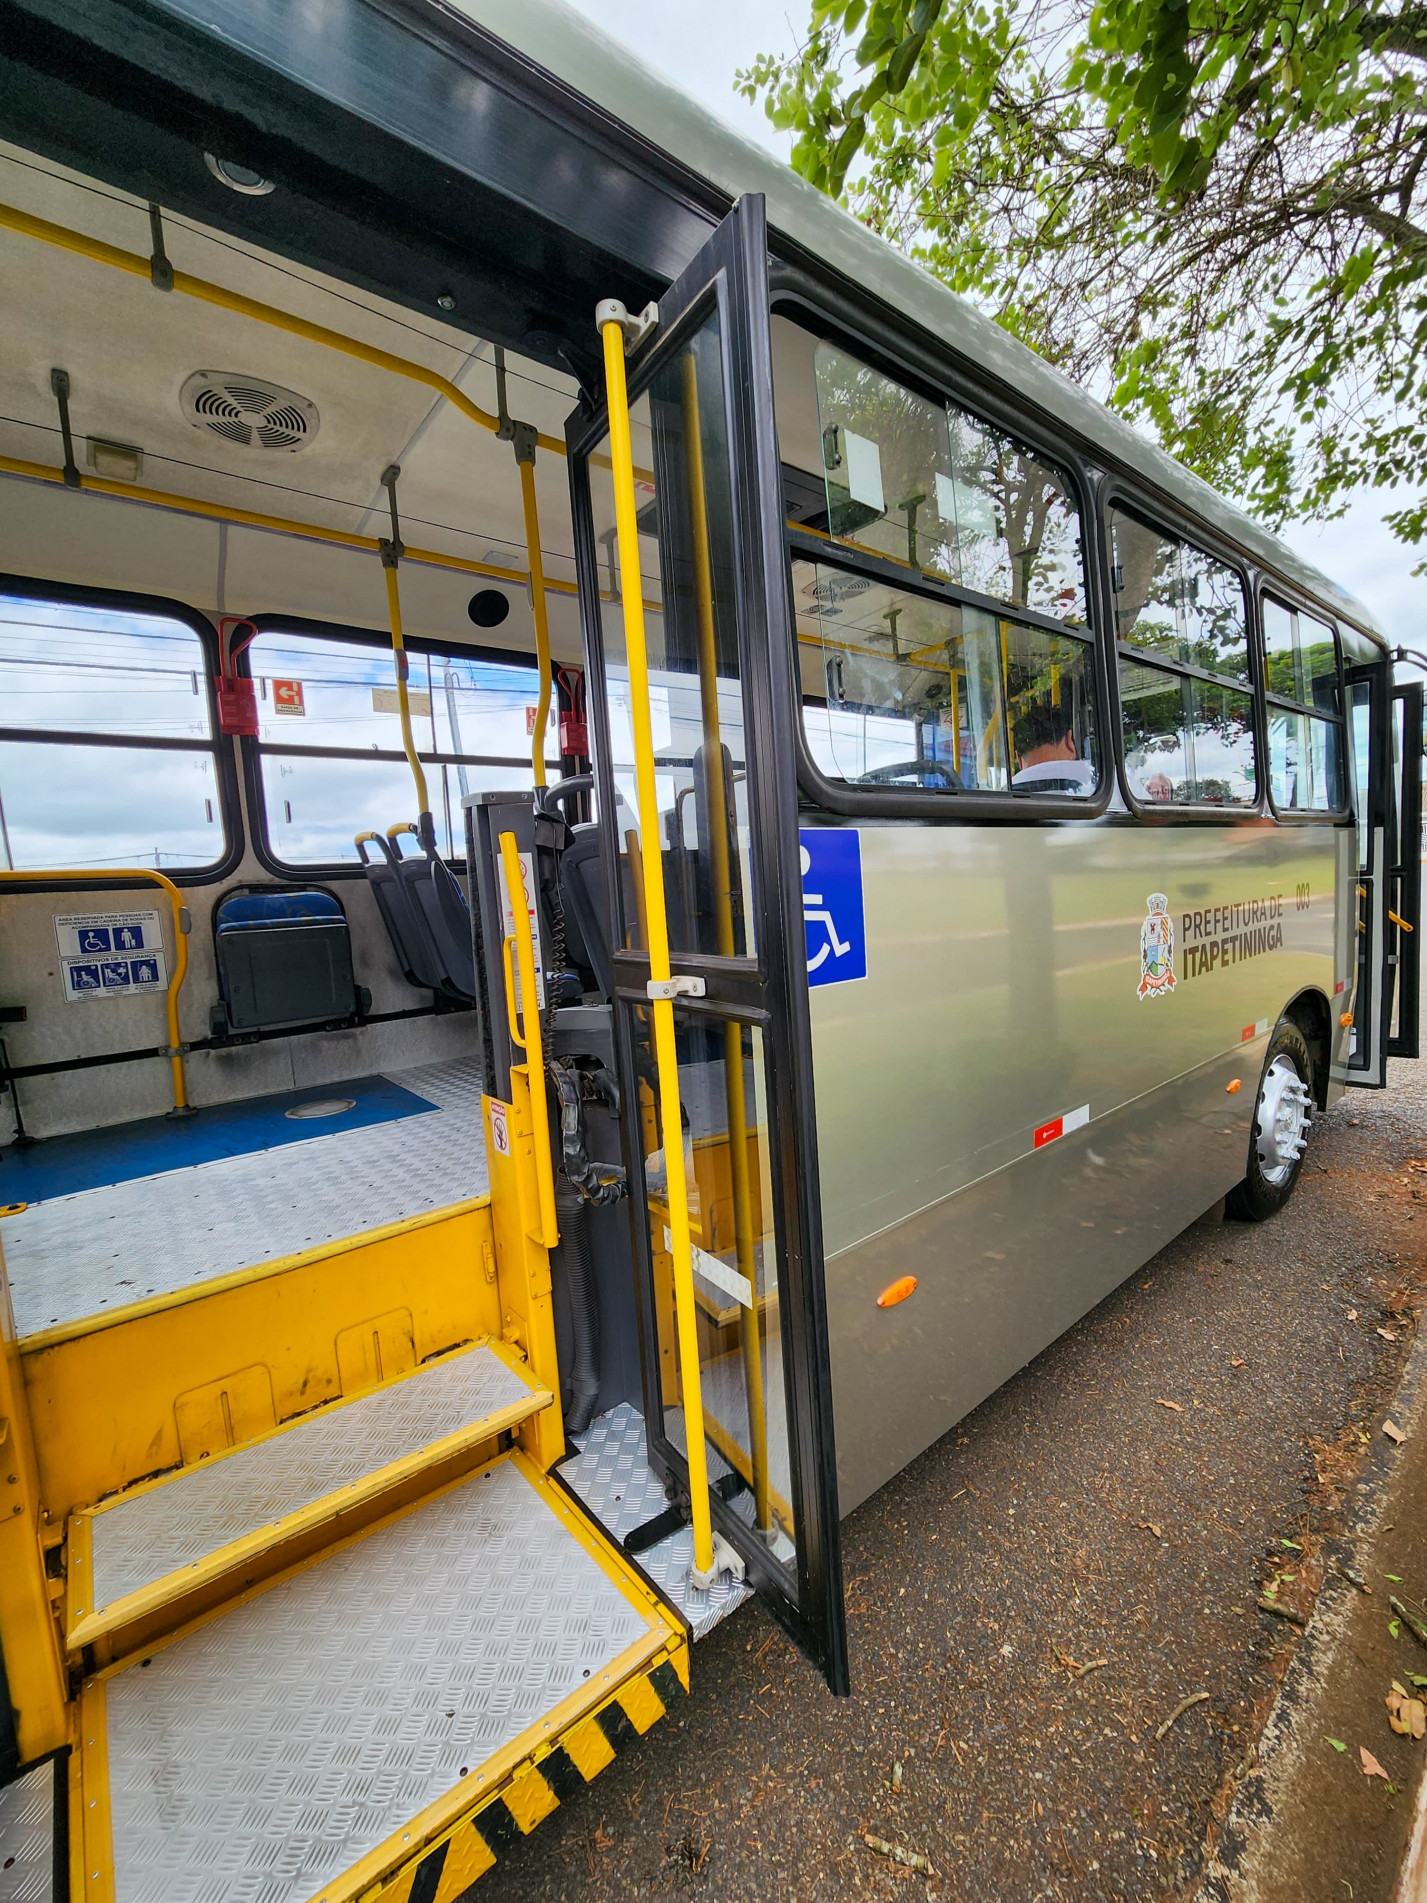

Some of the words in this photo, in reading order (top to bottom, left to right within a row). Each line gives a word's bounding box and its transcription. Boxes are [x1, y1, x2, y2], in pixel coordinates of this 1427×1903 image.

[1296, 882, 1310, 912] 003
[1182, 898, 1267, 943] PREFEITURA
[1269, 894, 1284, 920] DE
[67, 957, 110, 965] DISPOSITIVOS
[120, 953, 157, 961] SEGURANÇA
[1183, 922, 1283, 981] ITAPETININGA
